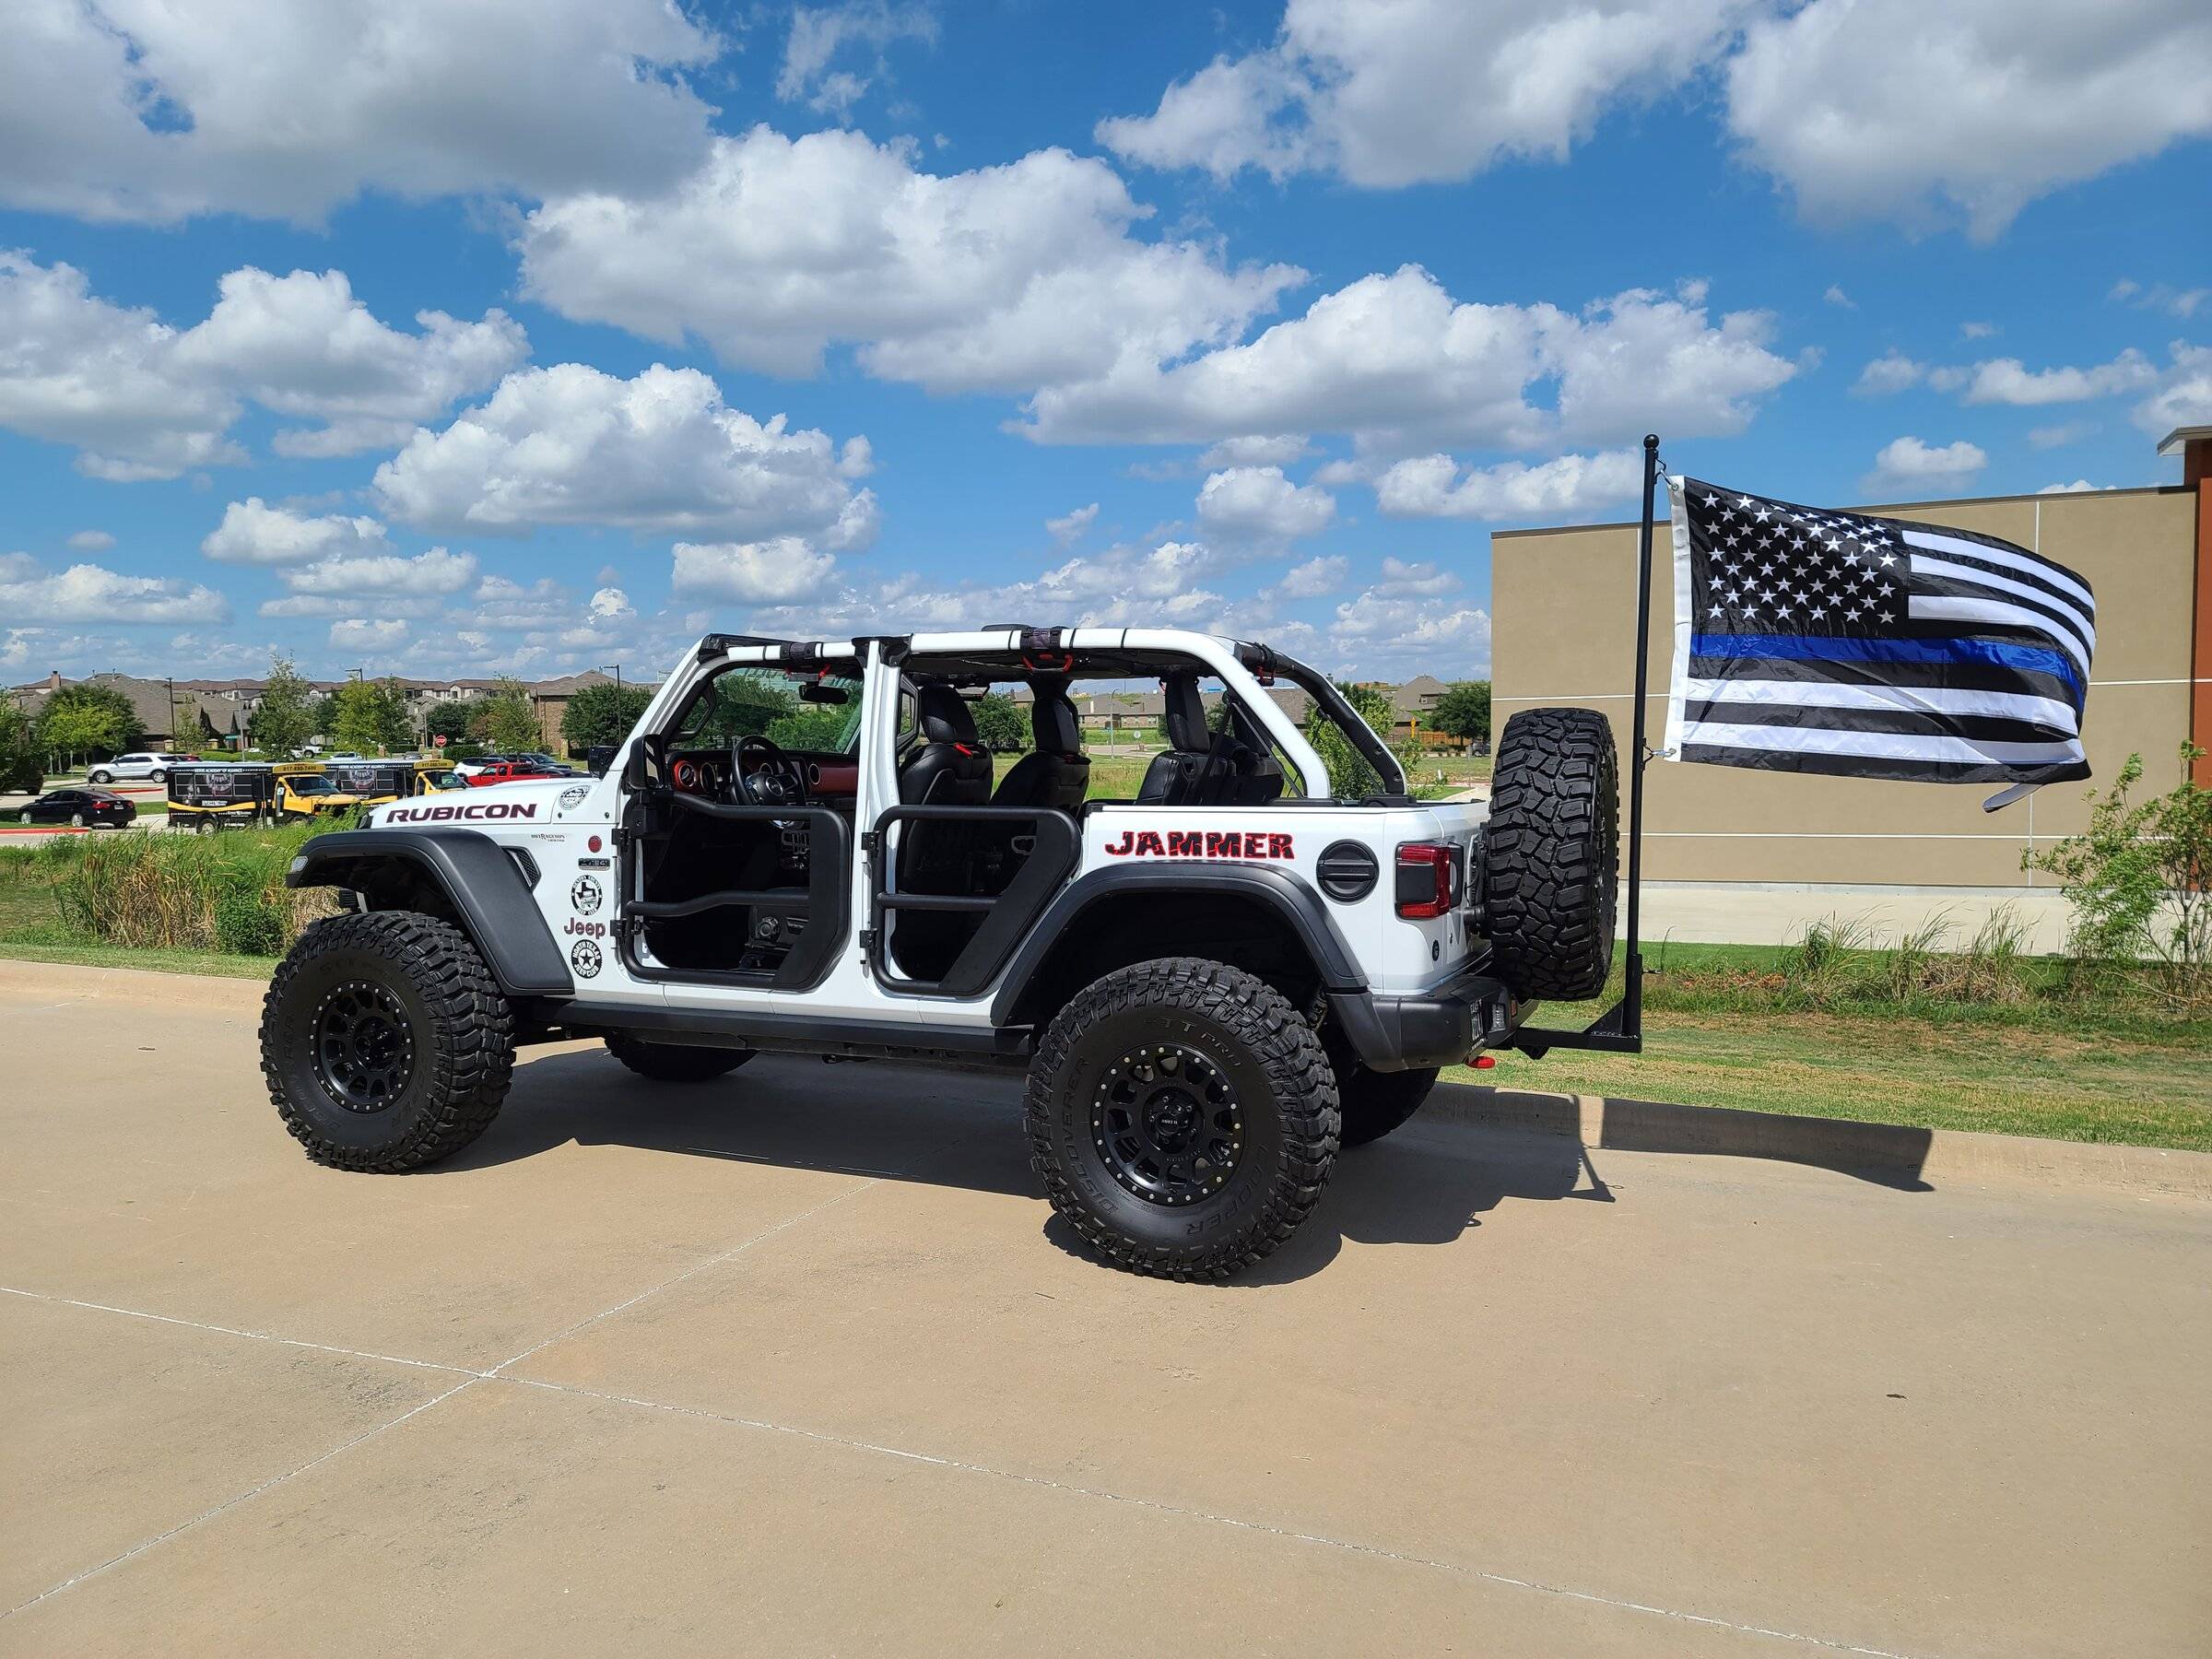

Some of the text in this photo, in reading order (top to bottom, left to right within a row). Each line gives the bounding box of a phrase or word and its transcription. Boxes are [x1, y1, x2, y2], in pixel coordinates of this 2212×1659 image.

[386, 803, 537, 823] RUBICON
[1104, 830, 1295, 860] JAMMER
[563, 917, 606, 940] Jeep
[572, 941, 601, 960] NORTH TEXAS
[574, 963, 600, 977] JEEP CLUB
